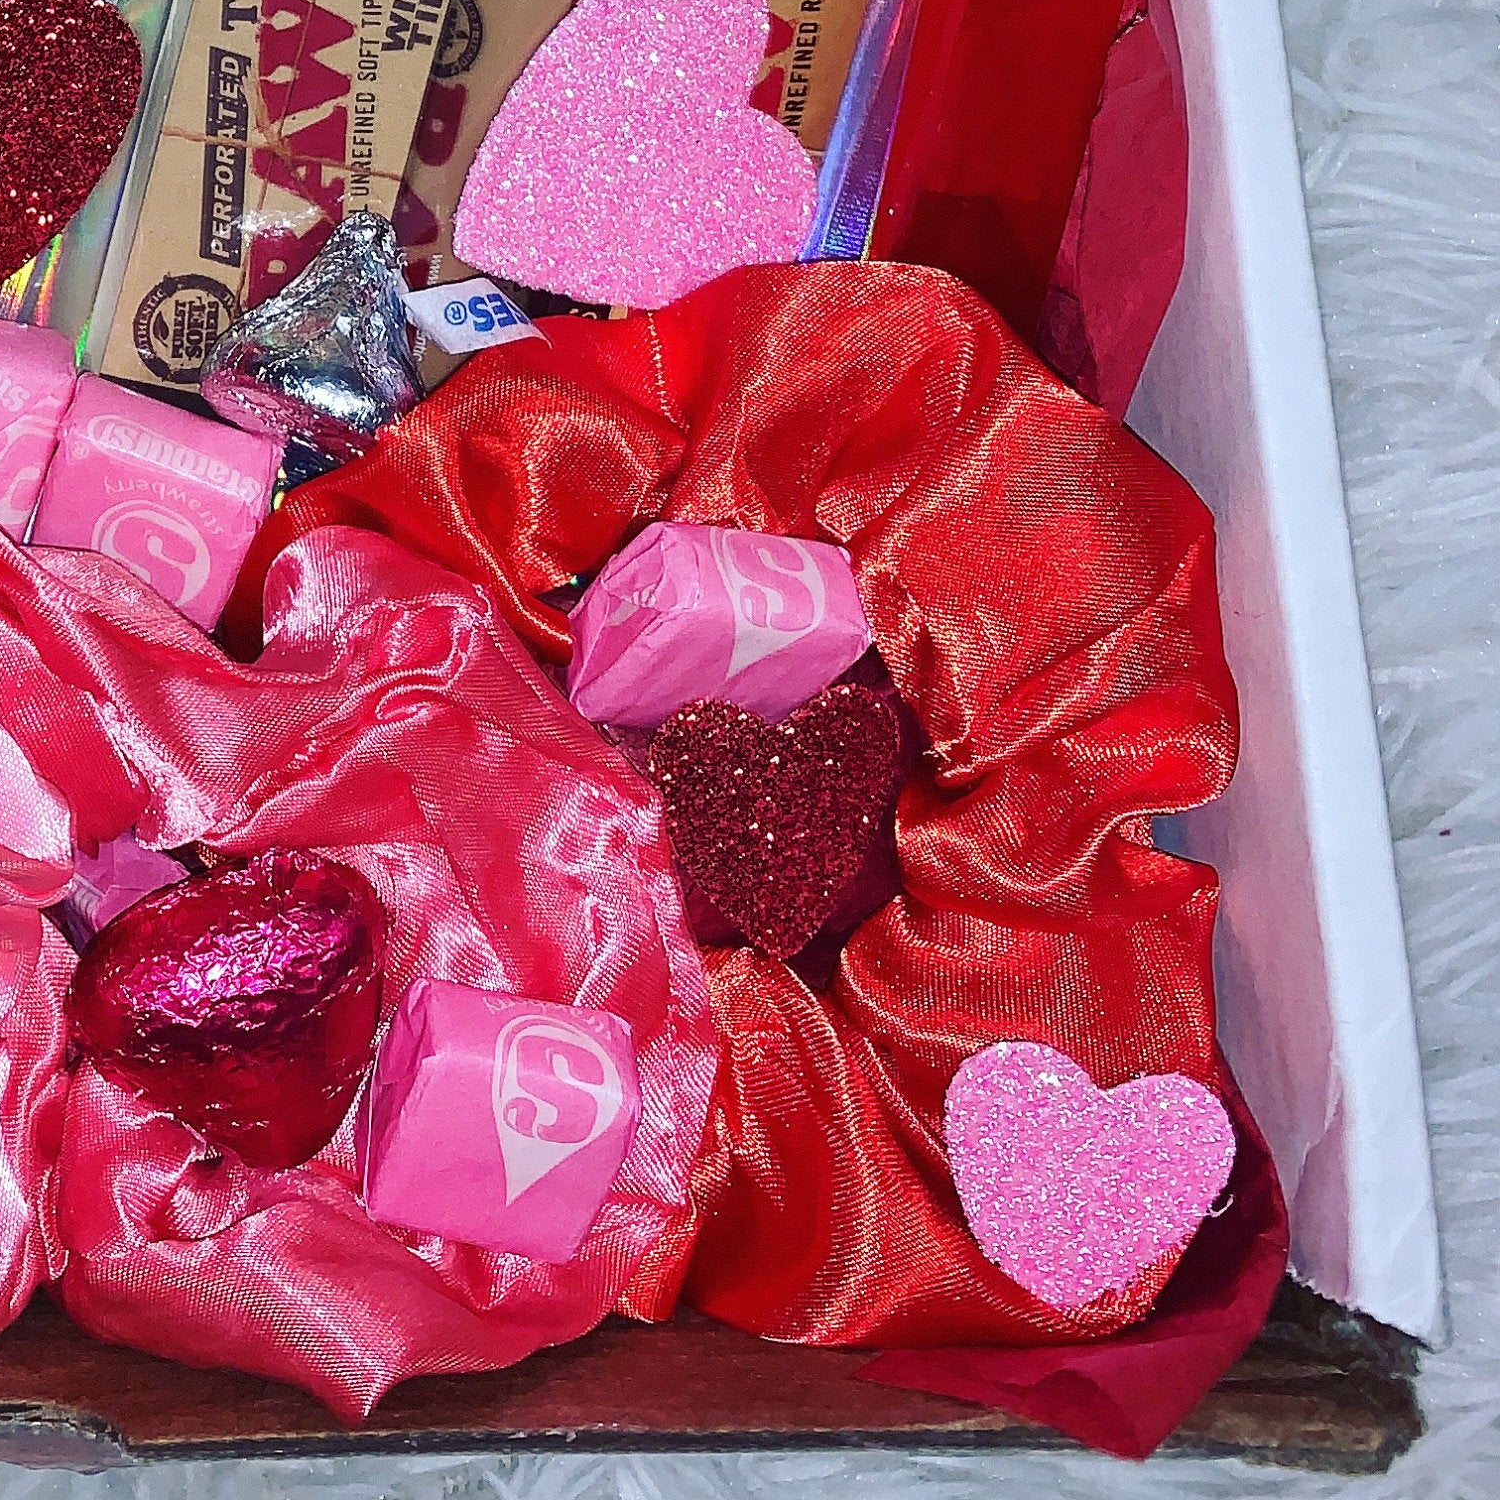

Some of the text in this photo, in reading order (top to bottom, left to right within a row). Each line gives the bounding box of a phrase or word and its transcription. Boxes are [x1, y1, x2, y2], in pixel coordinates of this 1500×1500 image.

[357, 35, 382, 82] SOFT
[210, 53, 240, 260] PERFORATED
[349, 91, 377, 197] UNREFINED
[184, 295, 207, 361] SOFT
